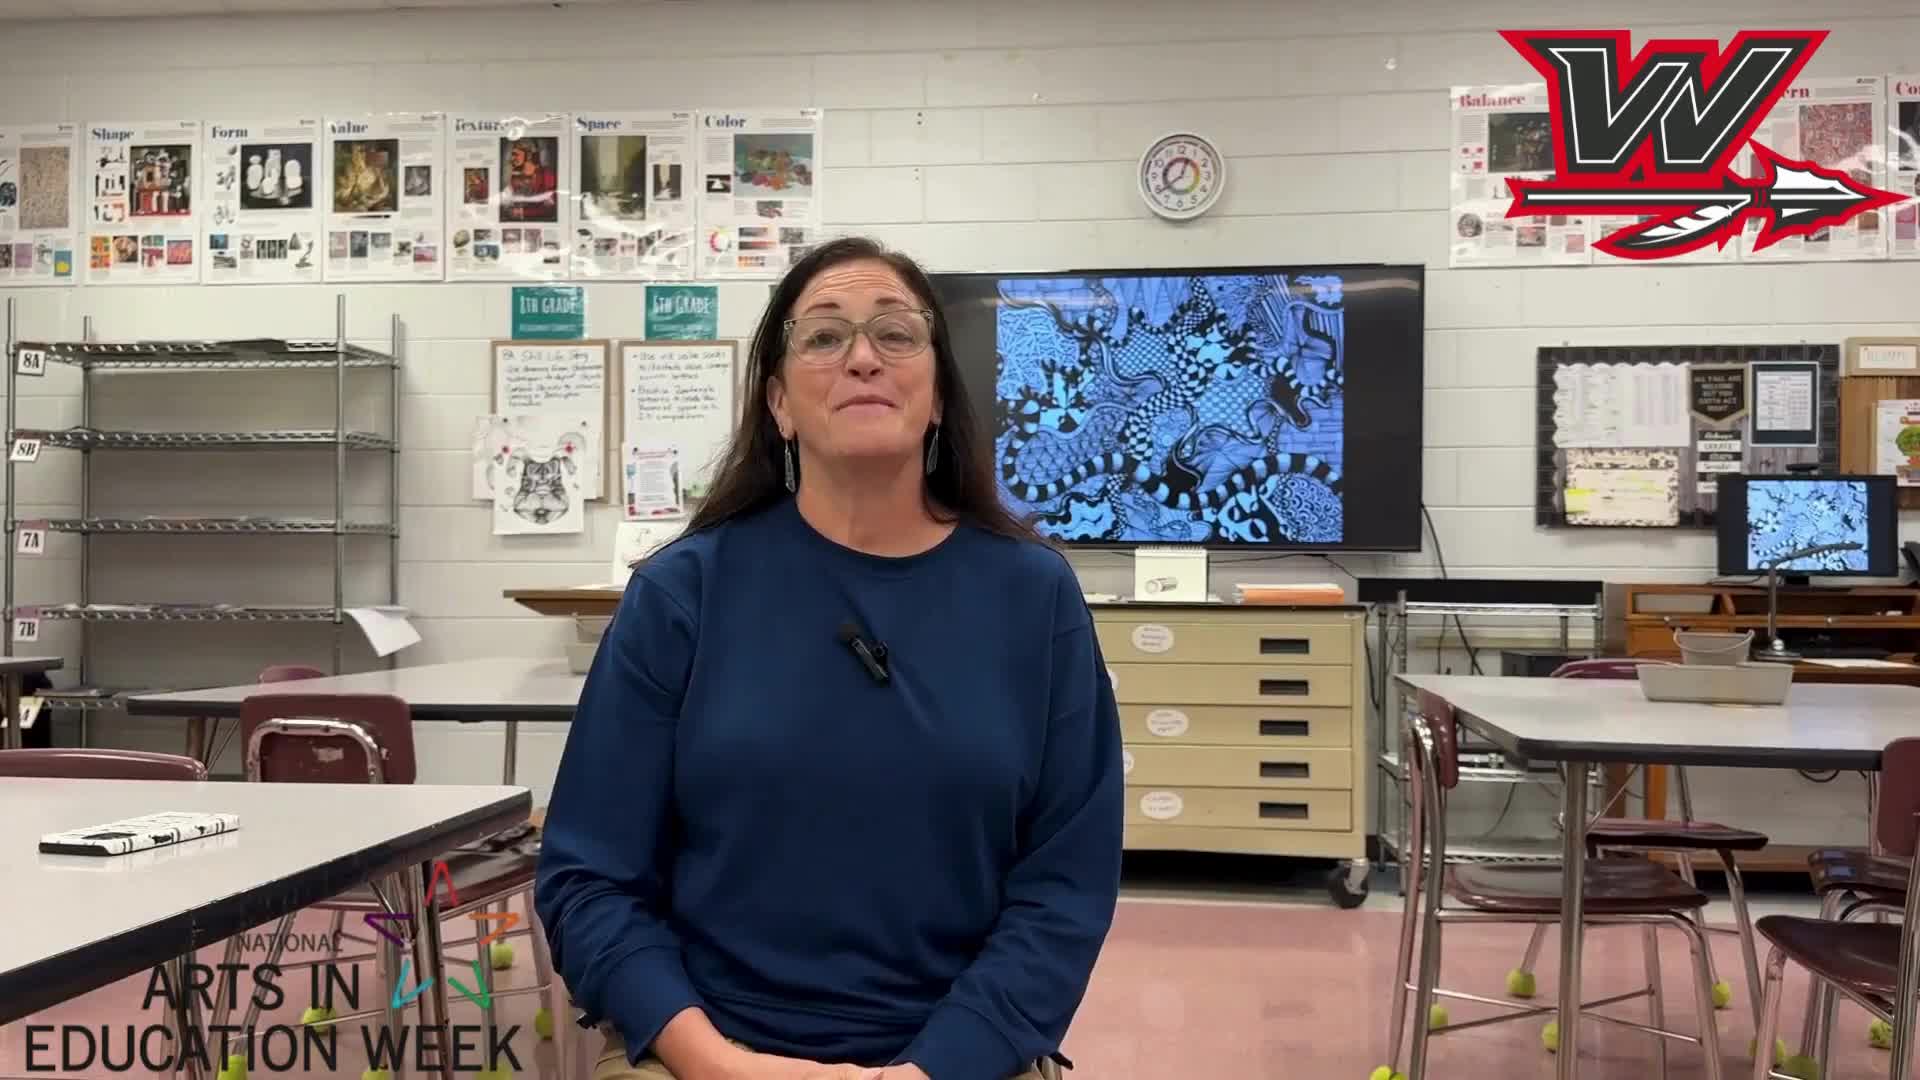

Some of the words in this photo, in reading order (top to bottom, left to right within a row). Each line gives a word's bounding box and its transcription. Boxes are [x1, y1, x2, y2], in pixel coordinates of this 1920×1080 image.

[1460, 94, 1526, 107] Balance
[331, 119, 369, 134] Value
[577, 117, 622, 131] Space
[705, 115, 746, 128] Color
[92, 127, 135, 142] Shape
[212, 126, 248, 139] Form
[542, 296, 580, 314] GRADE
[676, 296, 711, 314] GRADE
[22, 352, 40, 369] 8A
[17, 443, 37, 457] 8B
[23, 532, 40, 548] 7A
[19, 622, 36, 637] 7B
